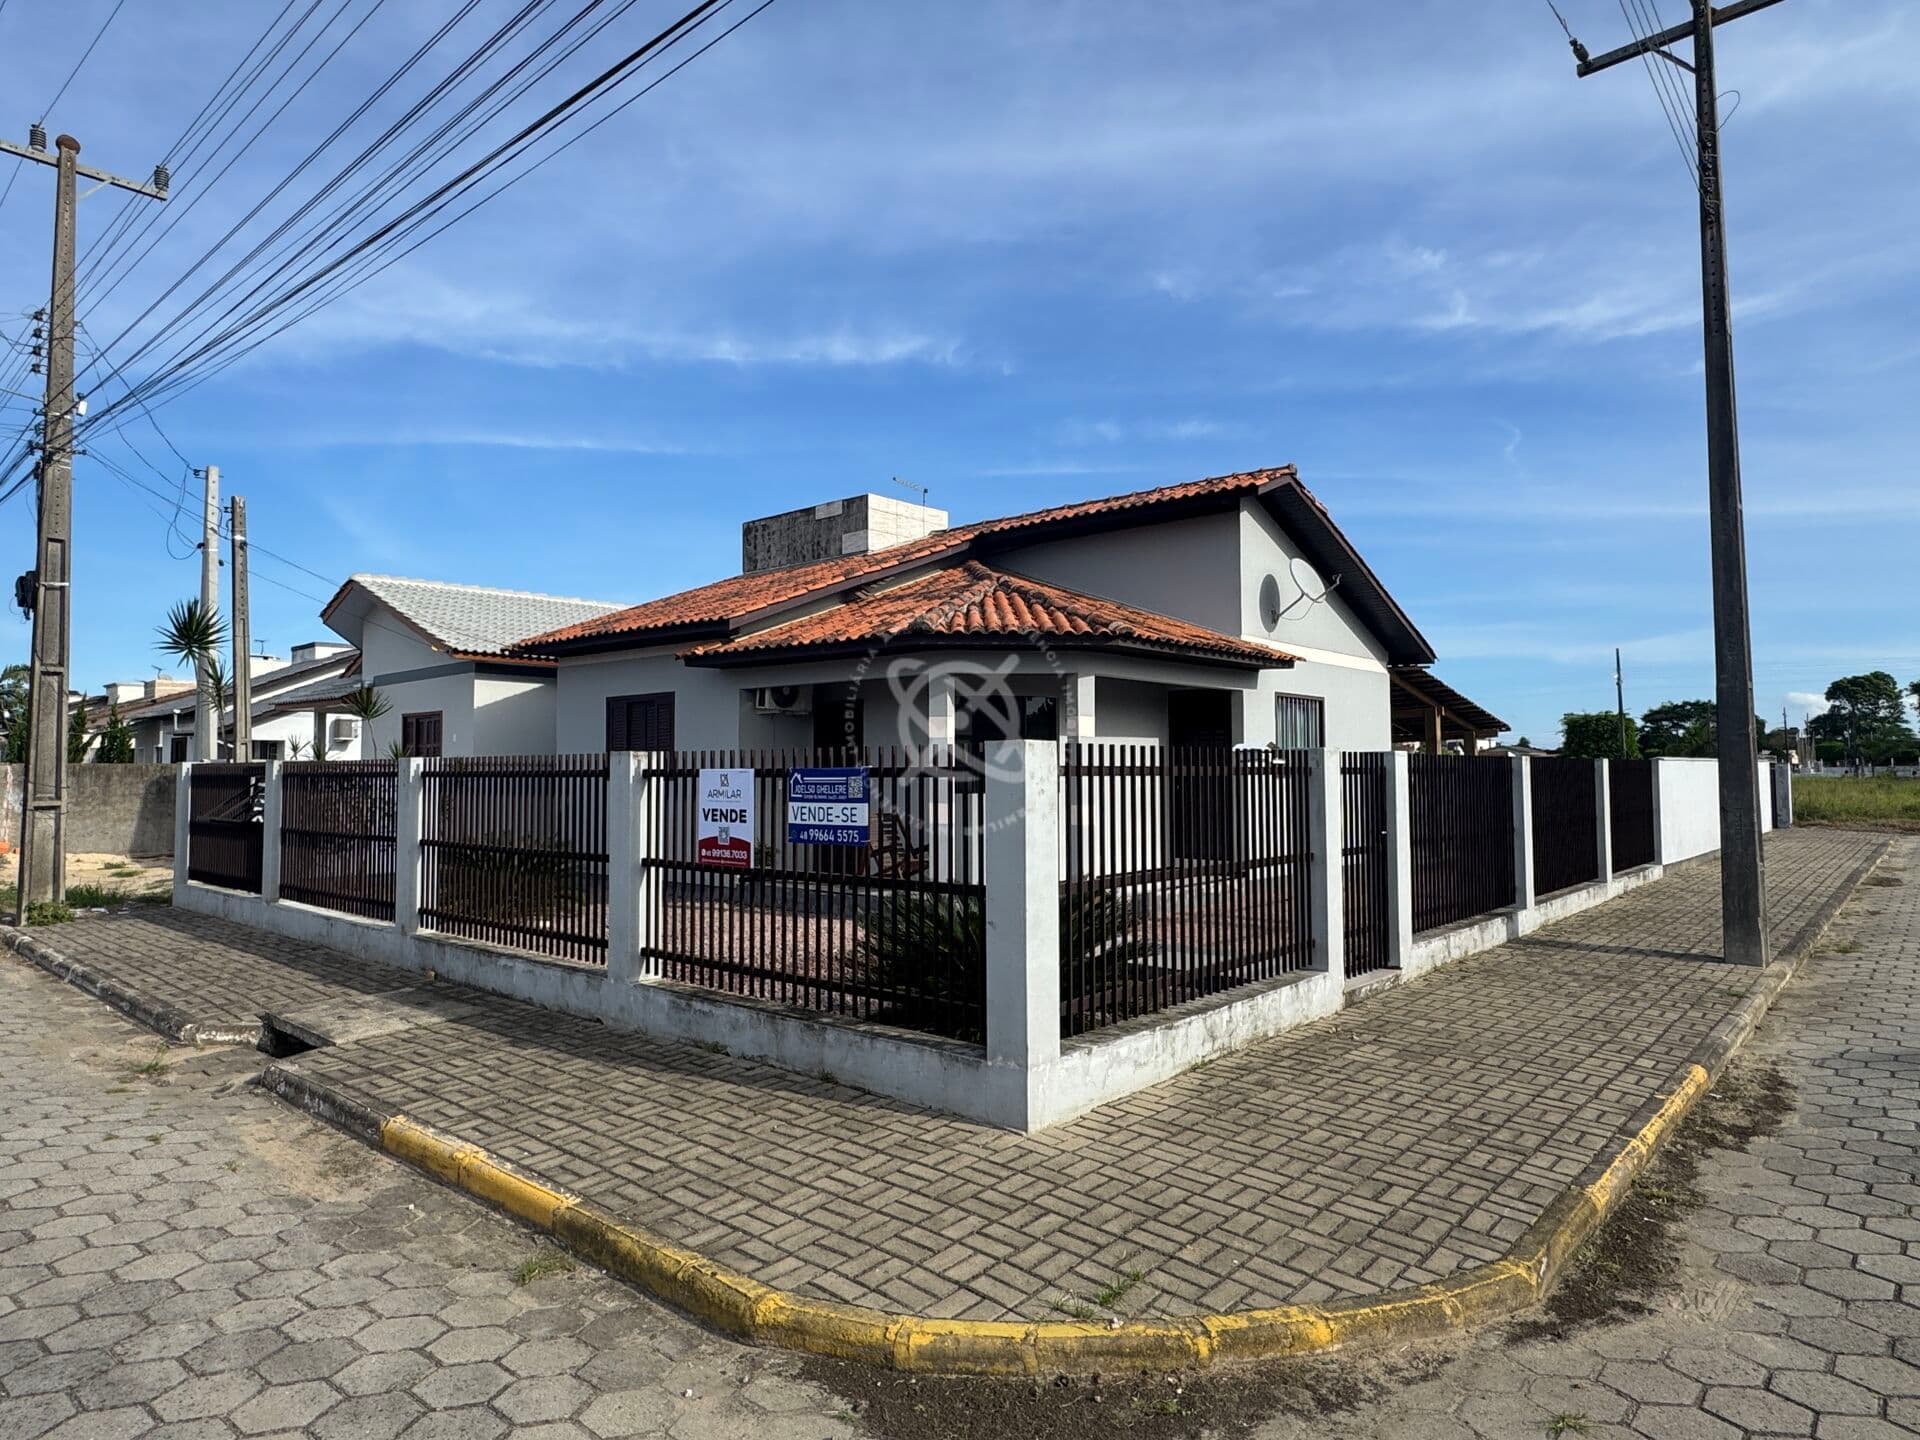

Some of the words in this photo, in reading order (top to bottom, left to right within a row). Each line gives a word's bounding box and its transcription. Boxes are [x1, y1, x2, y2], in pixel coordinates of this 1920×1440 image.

[708, 789, 742, 799] ARMILAR
[794, 784, 815, 794] JOELSO
[703, 808, 747, 824] VENDE
[792, 806, 858, 823] VENDE-SE
[809, 828, 835, 842] 99664
[837, 829, 859, 843] 5575
